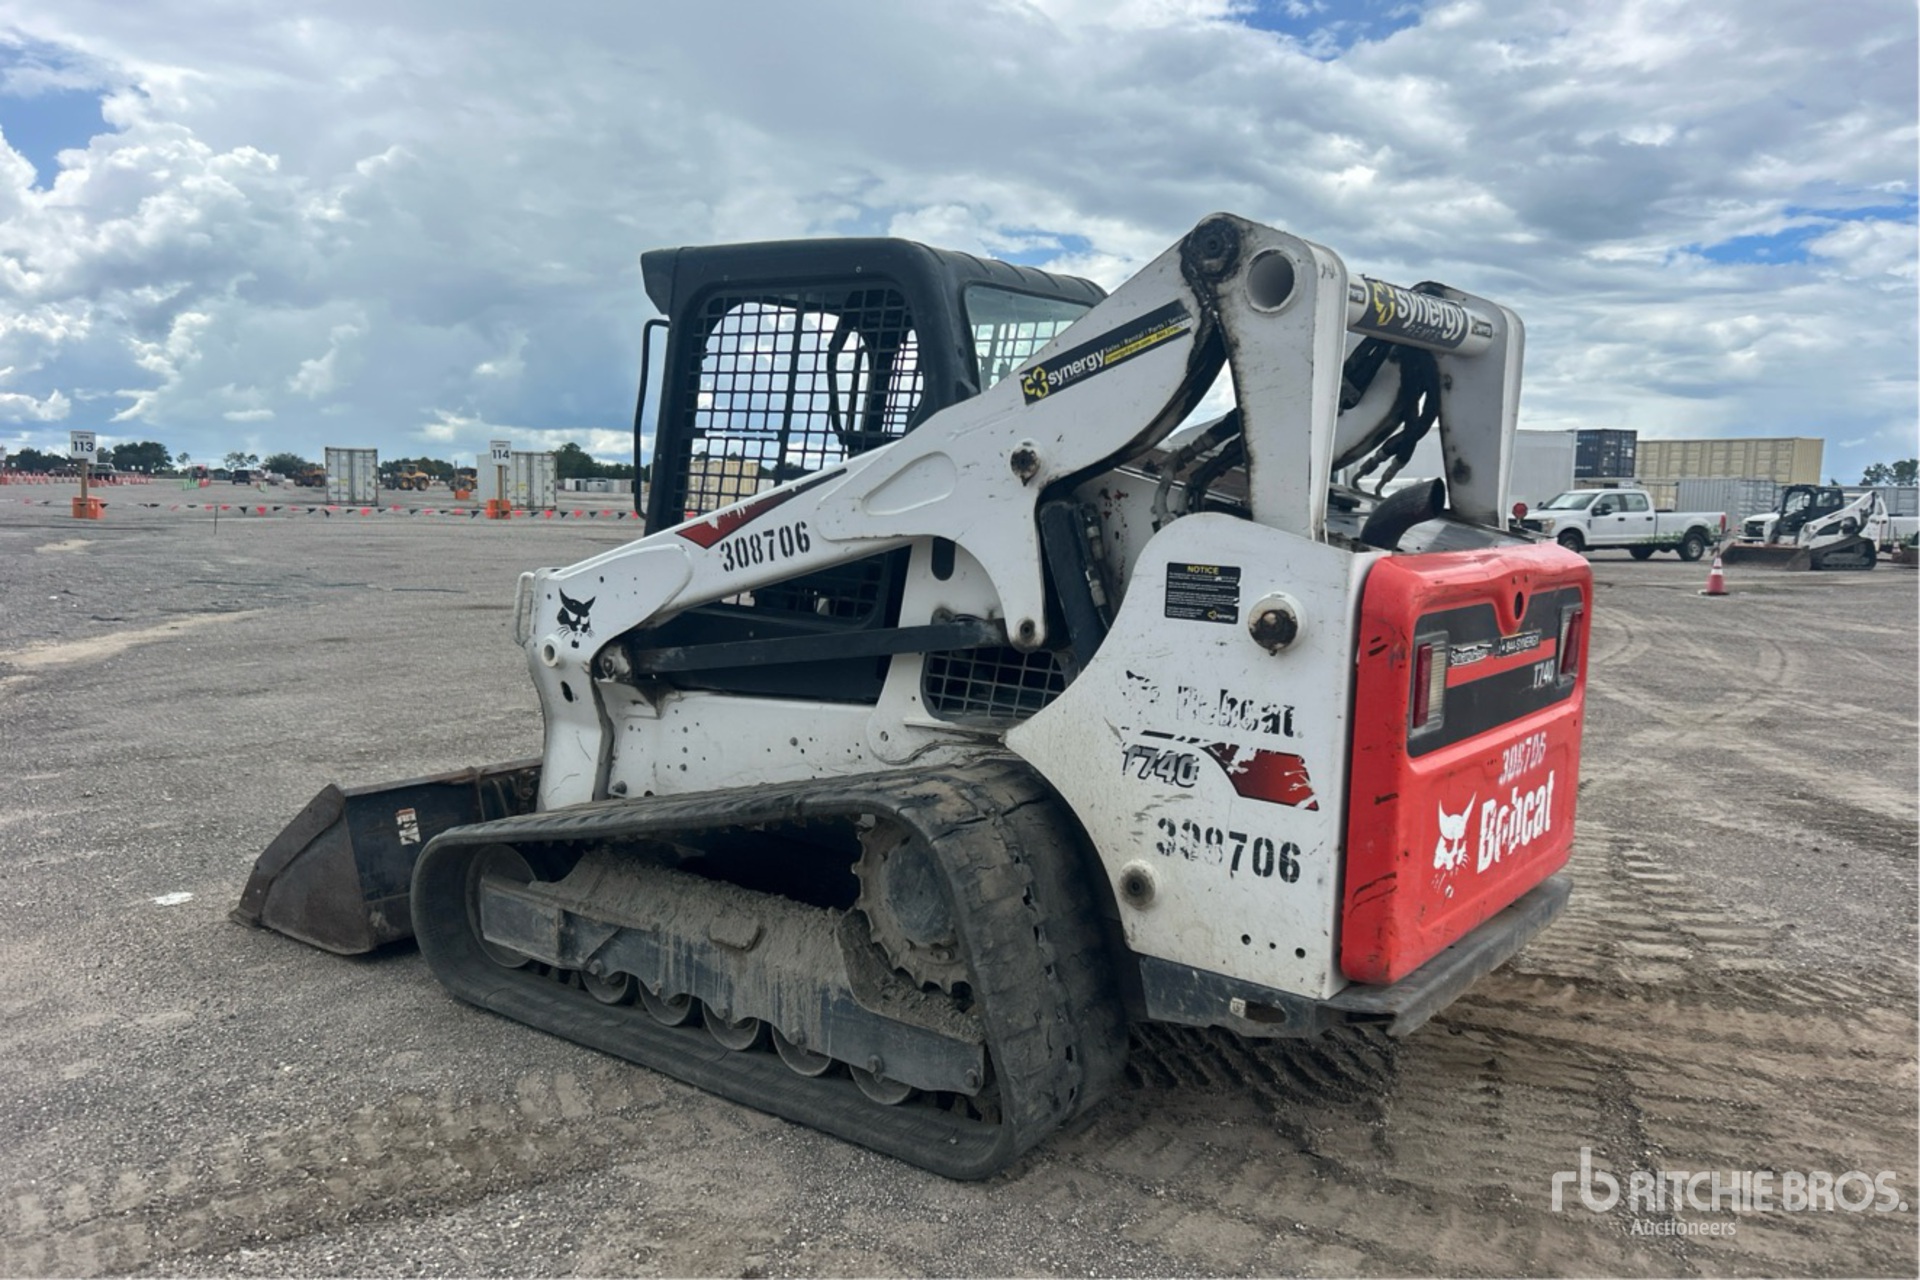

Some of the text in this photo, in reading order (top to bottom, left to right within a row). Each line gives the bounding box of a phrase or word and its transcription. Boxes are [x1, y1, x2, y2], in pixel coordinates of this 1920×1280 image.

[1395, 289, 1464, 340] synergy
[1048, 349, 1105, 385] synergy
[74, 441, 94, 452] 113
[493, 449, 510, 460] 114
[720, 521, 811, 572] 308706
[1187, 565, 1220, 575] NOTICE
[1533, 659, 1555, 689] T740
[1122, 744, 1200, 788] T740
[1476, 769, 1555, 874] Bobcat
